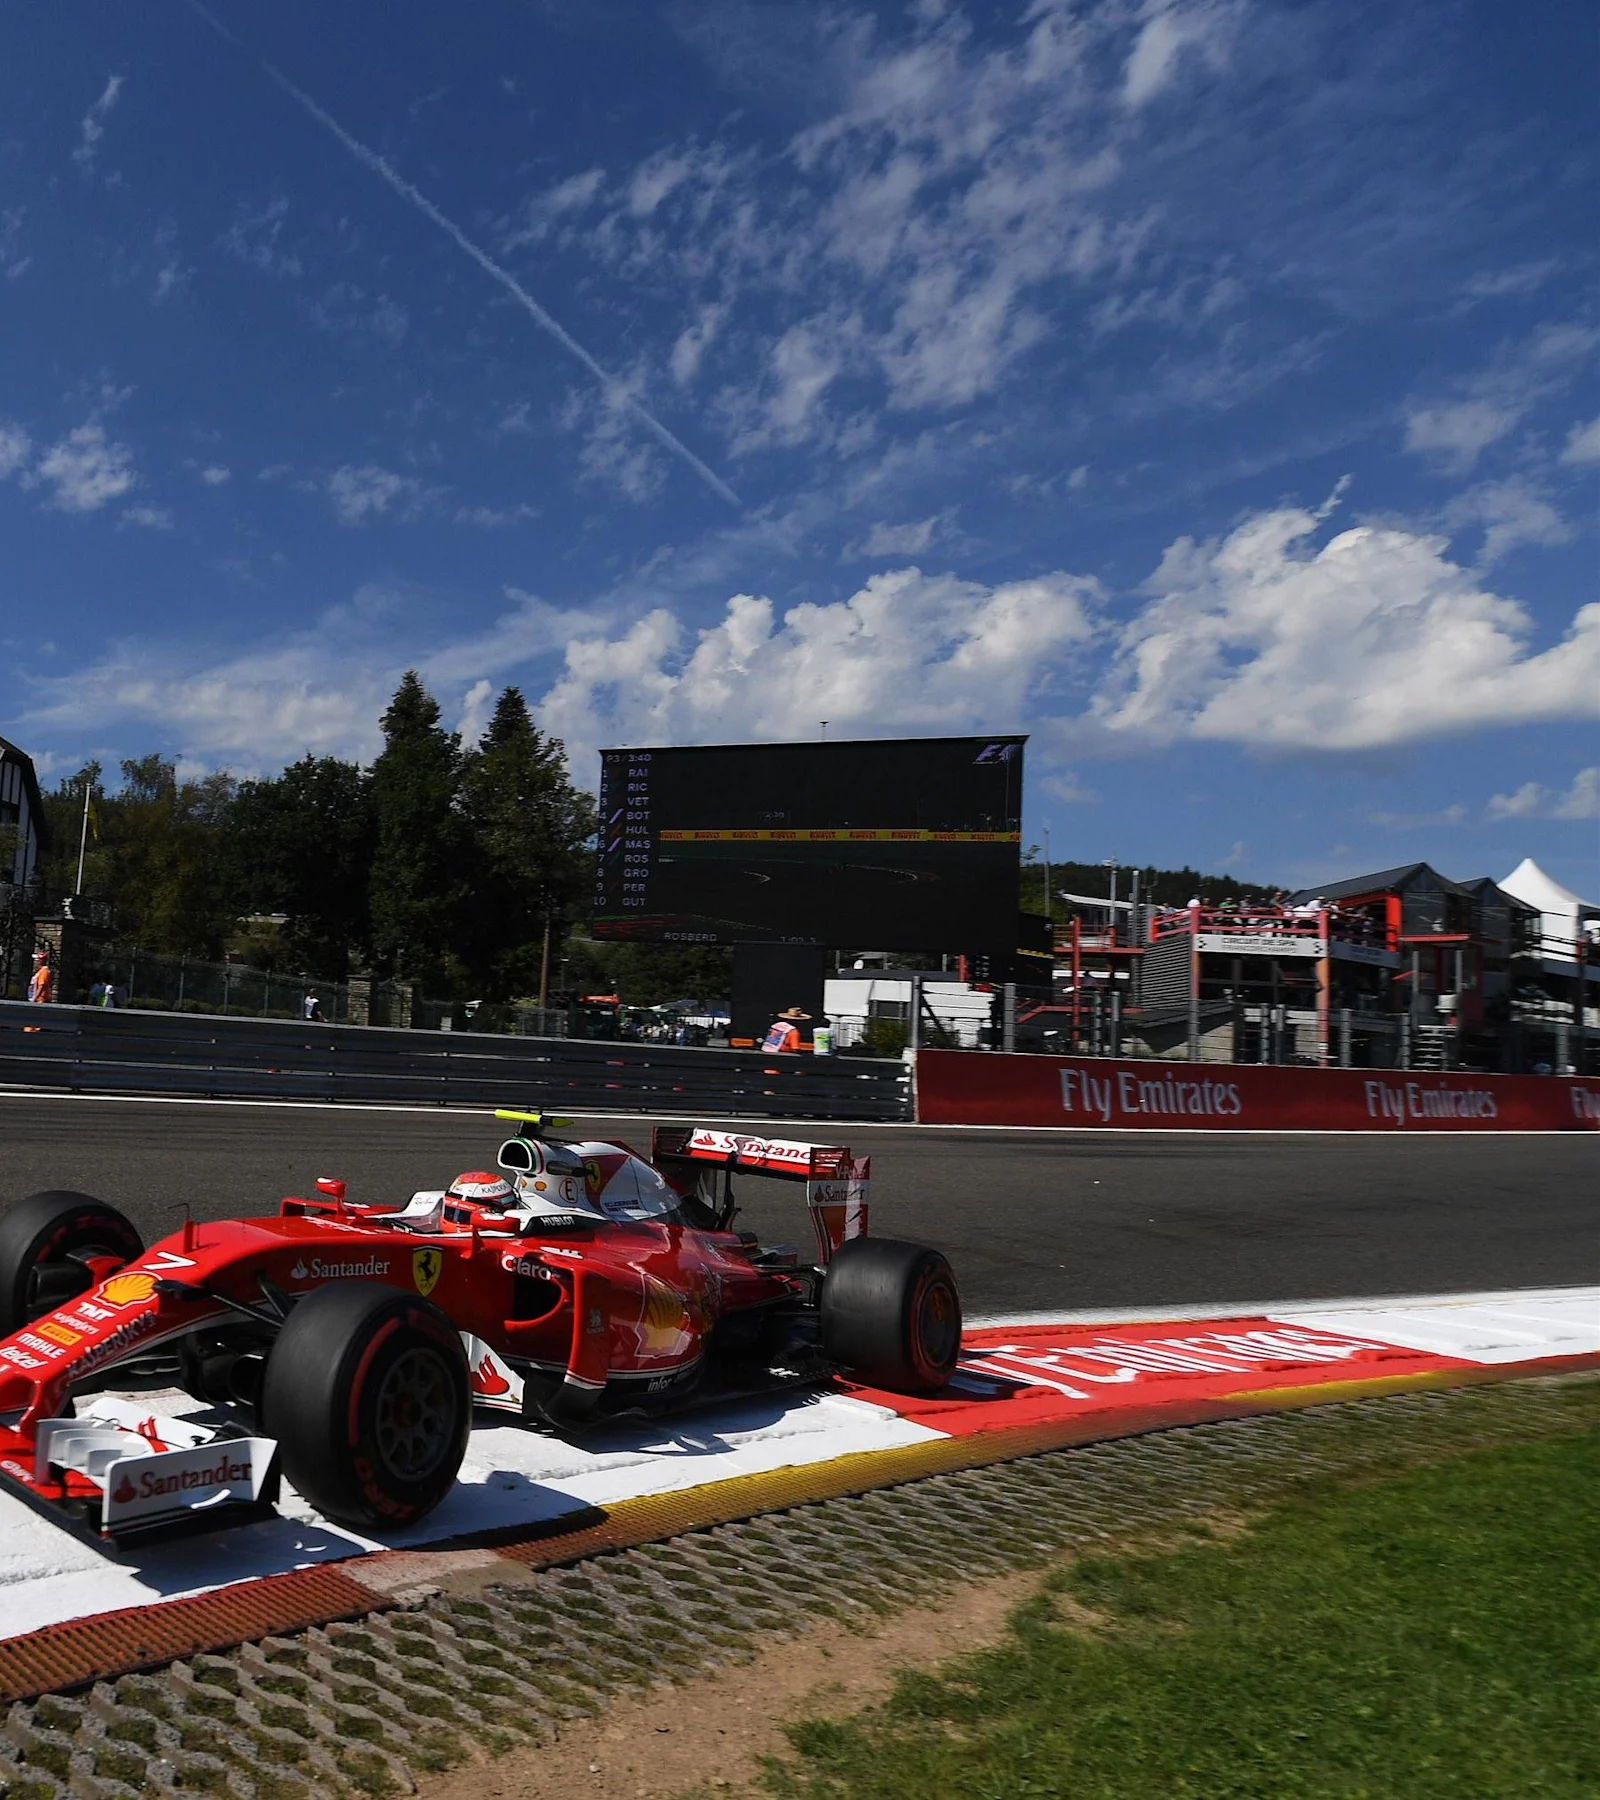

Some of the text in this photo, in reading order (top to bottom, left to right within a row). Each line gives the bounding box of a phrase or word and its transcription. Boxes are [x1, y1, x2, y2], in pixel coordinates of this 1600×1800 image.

[601, 782, 648, 792] 2 RIC
[601, 796, 650, 806] 3 VET
[626, 811, 650, 820] BOT
[600, 825, 649, 835] 5 HUL
[599, 839, 651, 849] 6 MAS
[598, 853, 649, 863] 7 ROS
[596, 867, 649, 878] 8 GRO
[596, 882, 646, 892] 9 PER
[593, 896, 646, 906] 10 GUT
[1221, 936, 1296, 947] CIRCUIT DE SPA
[1059, 1068, 1241, 1122] Fly Emirates
[1364, 1080, 1497, 1126] Fly Emirates
[540, 1216, 576, 1227] HUBLOT
[141, 1250, 198, 1270] 7
[310, 1255, 391, 1279] Santander
[501, 1254, 551, 1281] Claro
[75, 1302, 116, 1320] TNT
[16, 1332, 67, 1360] MAHLE
[647, 1376, 672, 1392] infor
[140, 1456, 253, 1499] Santander
